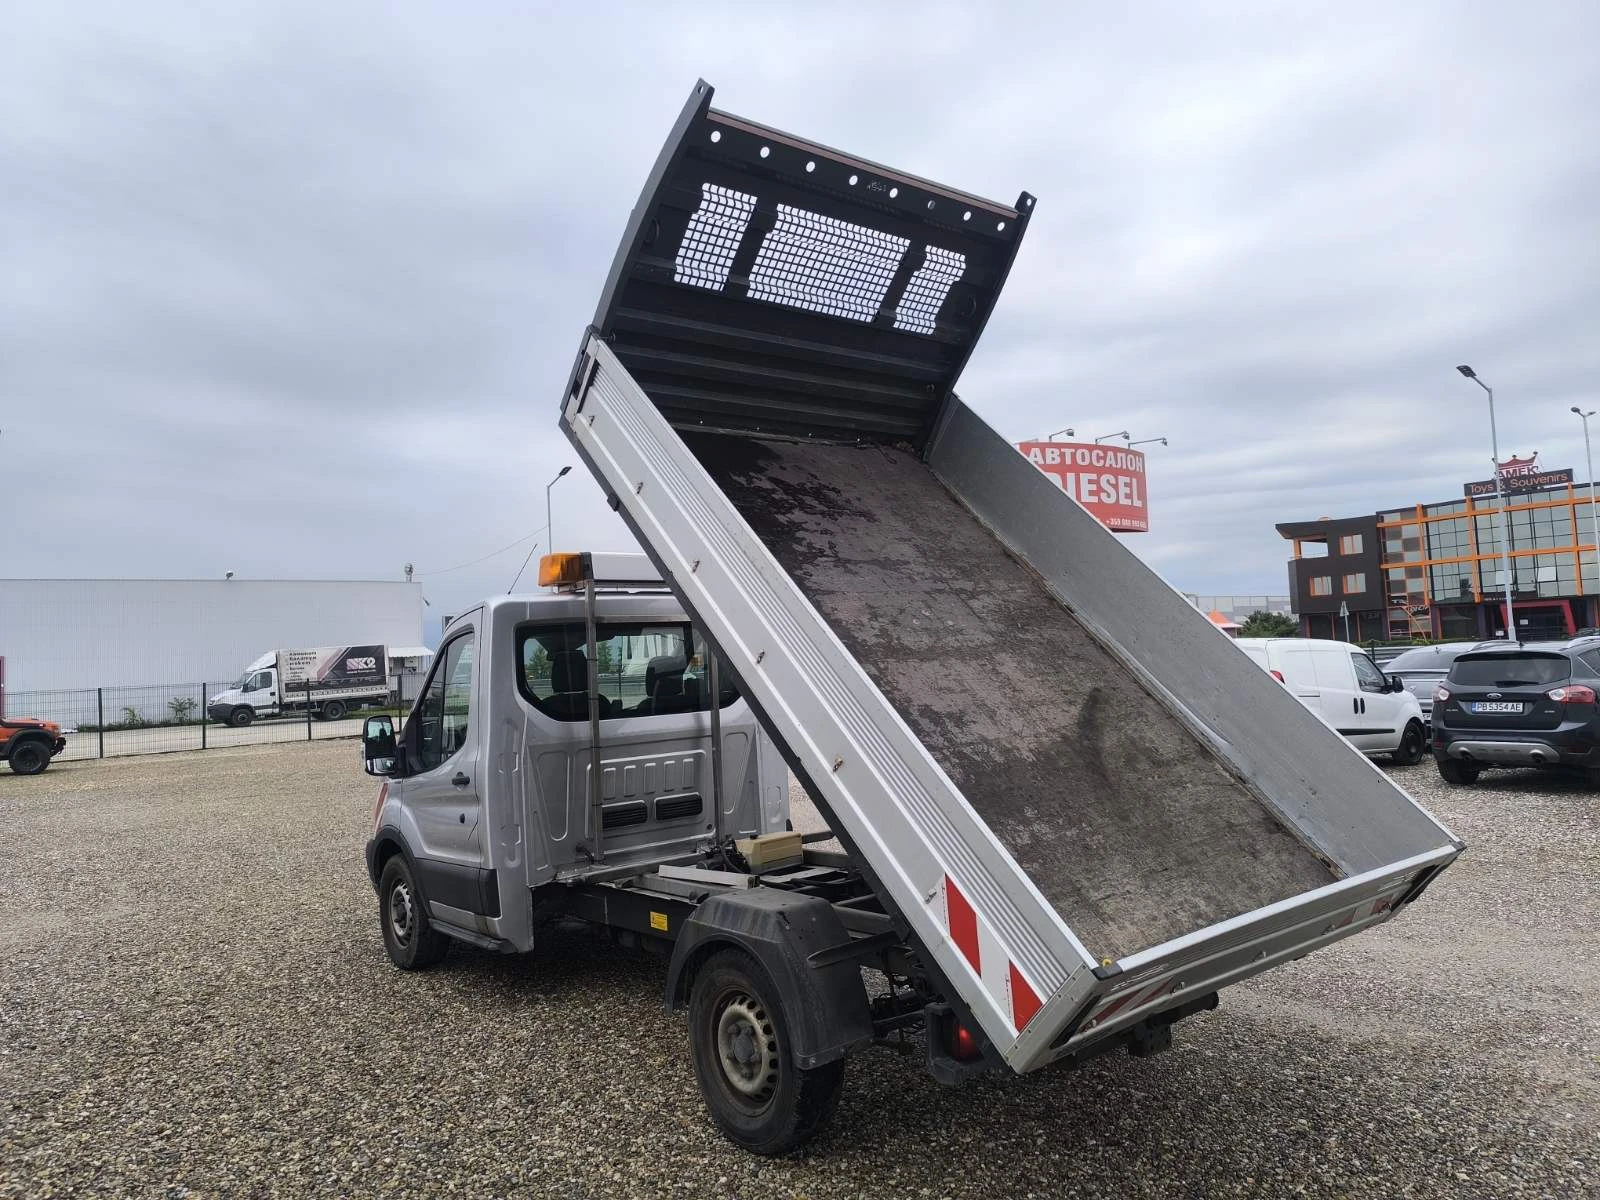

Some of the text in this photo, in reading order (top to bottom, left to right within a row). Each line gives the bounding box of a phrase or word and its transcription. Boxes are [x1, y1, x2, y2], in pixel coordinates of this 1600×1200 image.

[1028, 447, 1144, 473] АВТОСАЛОН
[1471, 483, 1494, 495] Toys
[1510, 472, 1568, 488] Souvenirs
